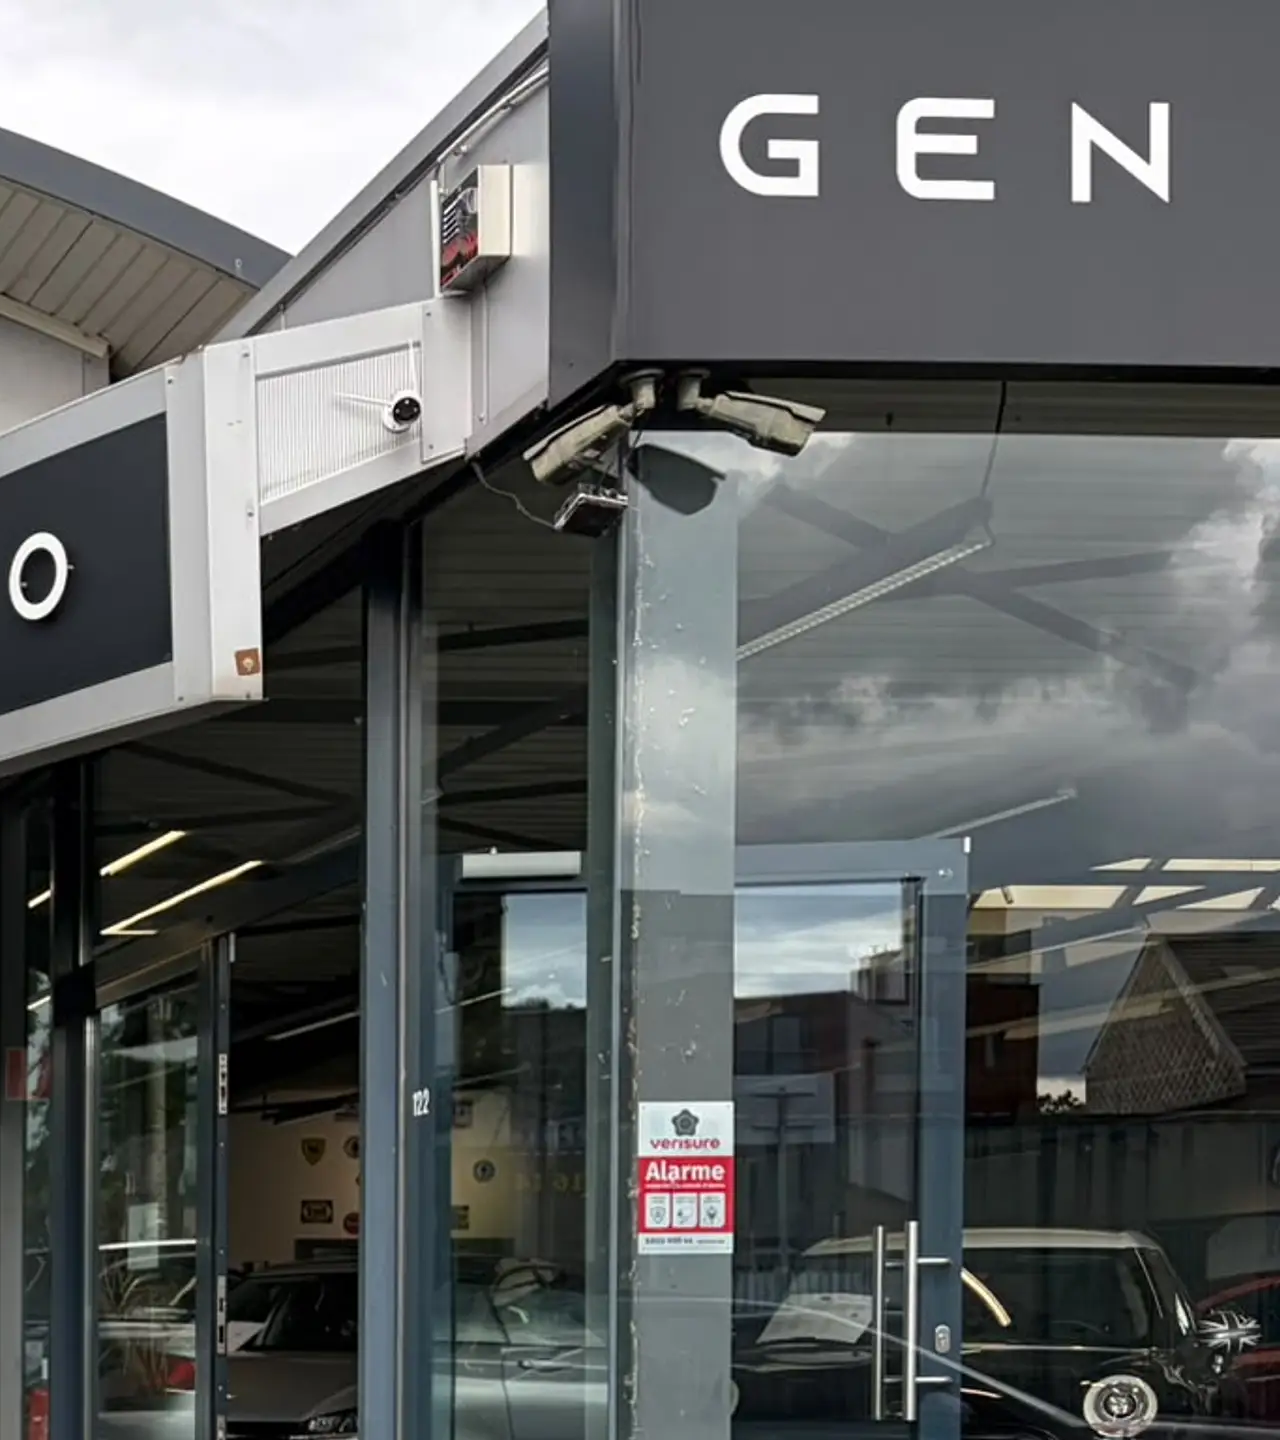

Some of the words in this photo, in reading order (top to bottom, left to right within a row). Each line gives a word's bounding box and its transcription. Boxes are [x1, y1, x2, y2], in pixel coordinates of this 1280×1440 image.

[719, 94, 1172, 203] GEN
[412, 1087, 430, 1117] 122
[649, 1137, 721, 1151] verisure
[645, 1160, 726, 1181] Alarme
